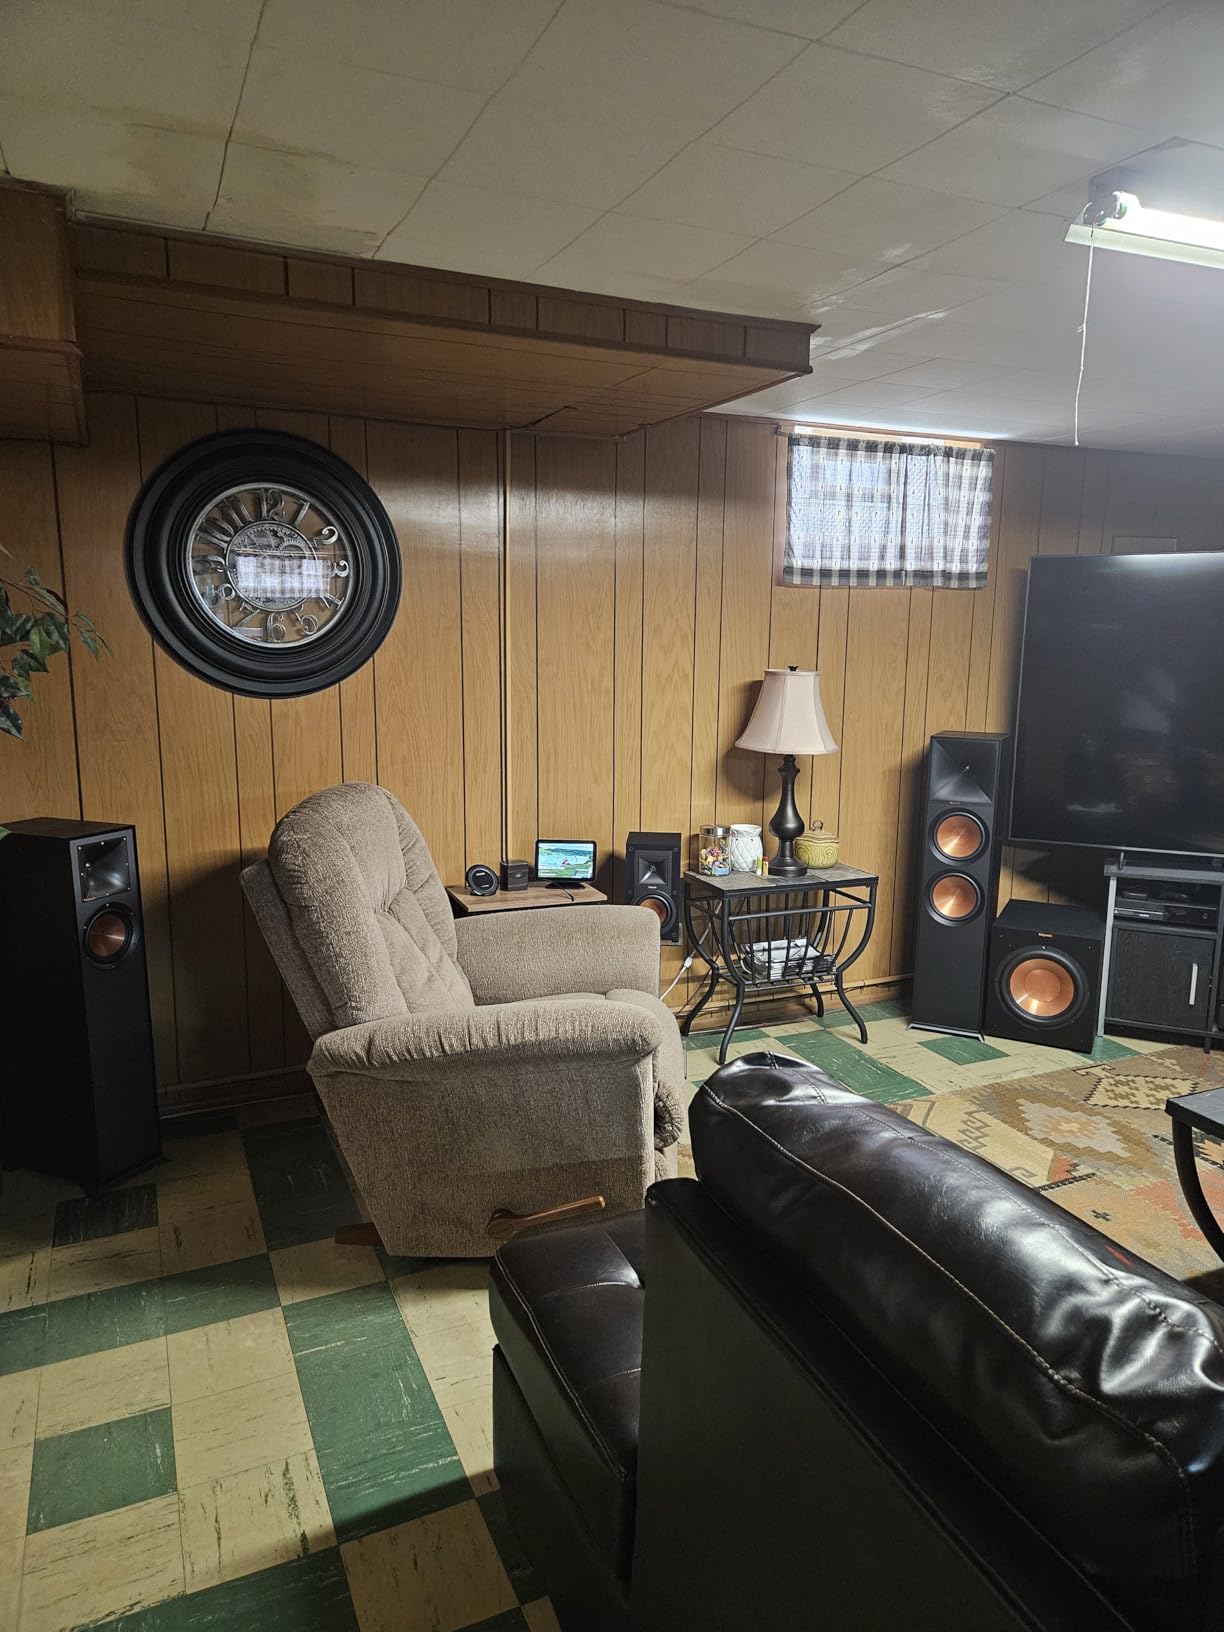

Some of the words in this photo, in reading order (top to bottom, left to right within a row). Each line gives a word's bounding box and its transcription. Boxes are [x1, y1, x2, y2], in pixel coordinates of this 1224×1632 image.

[252, 488, 286, 521] 12
[292, 499, 311, 527] 1
[312, 525, 339, 548] 2
[330, 560, 350, 578] 3
[266, 612, 287, 642] 6
[293, 604, 319, 635] 5
